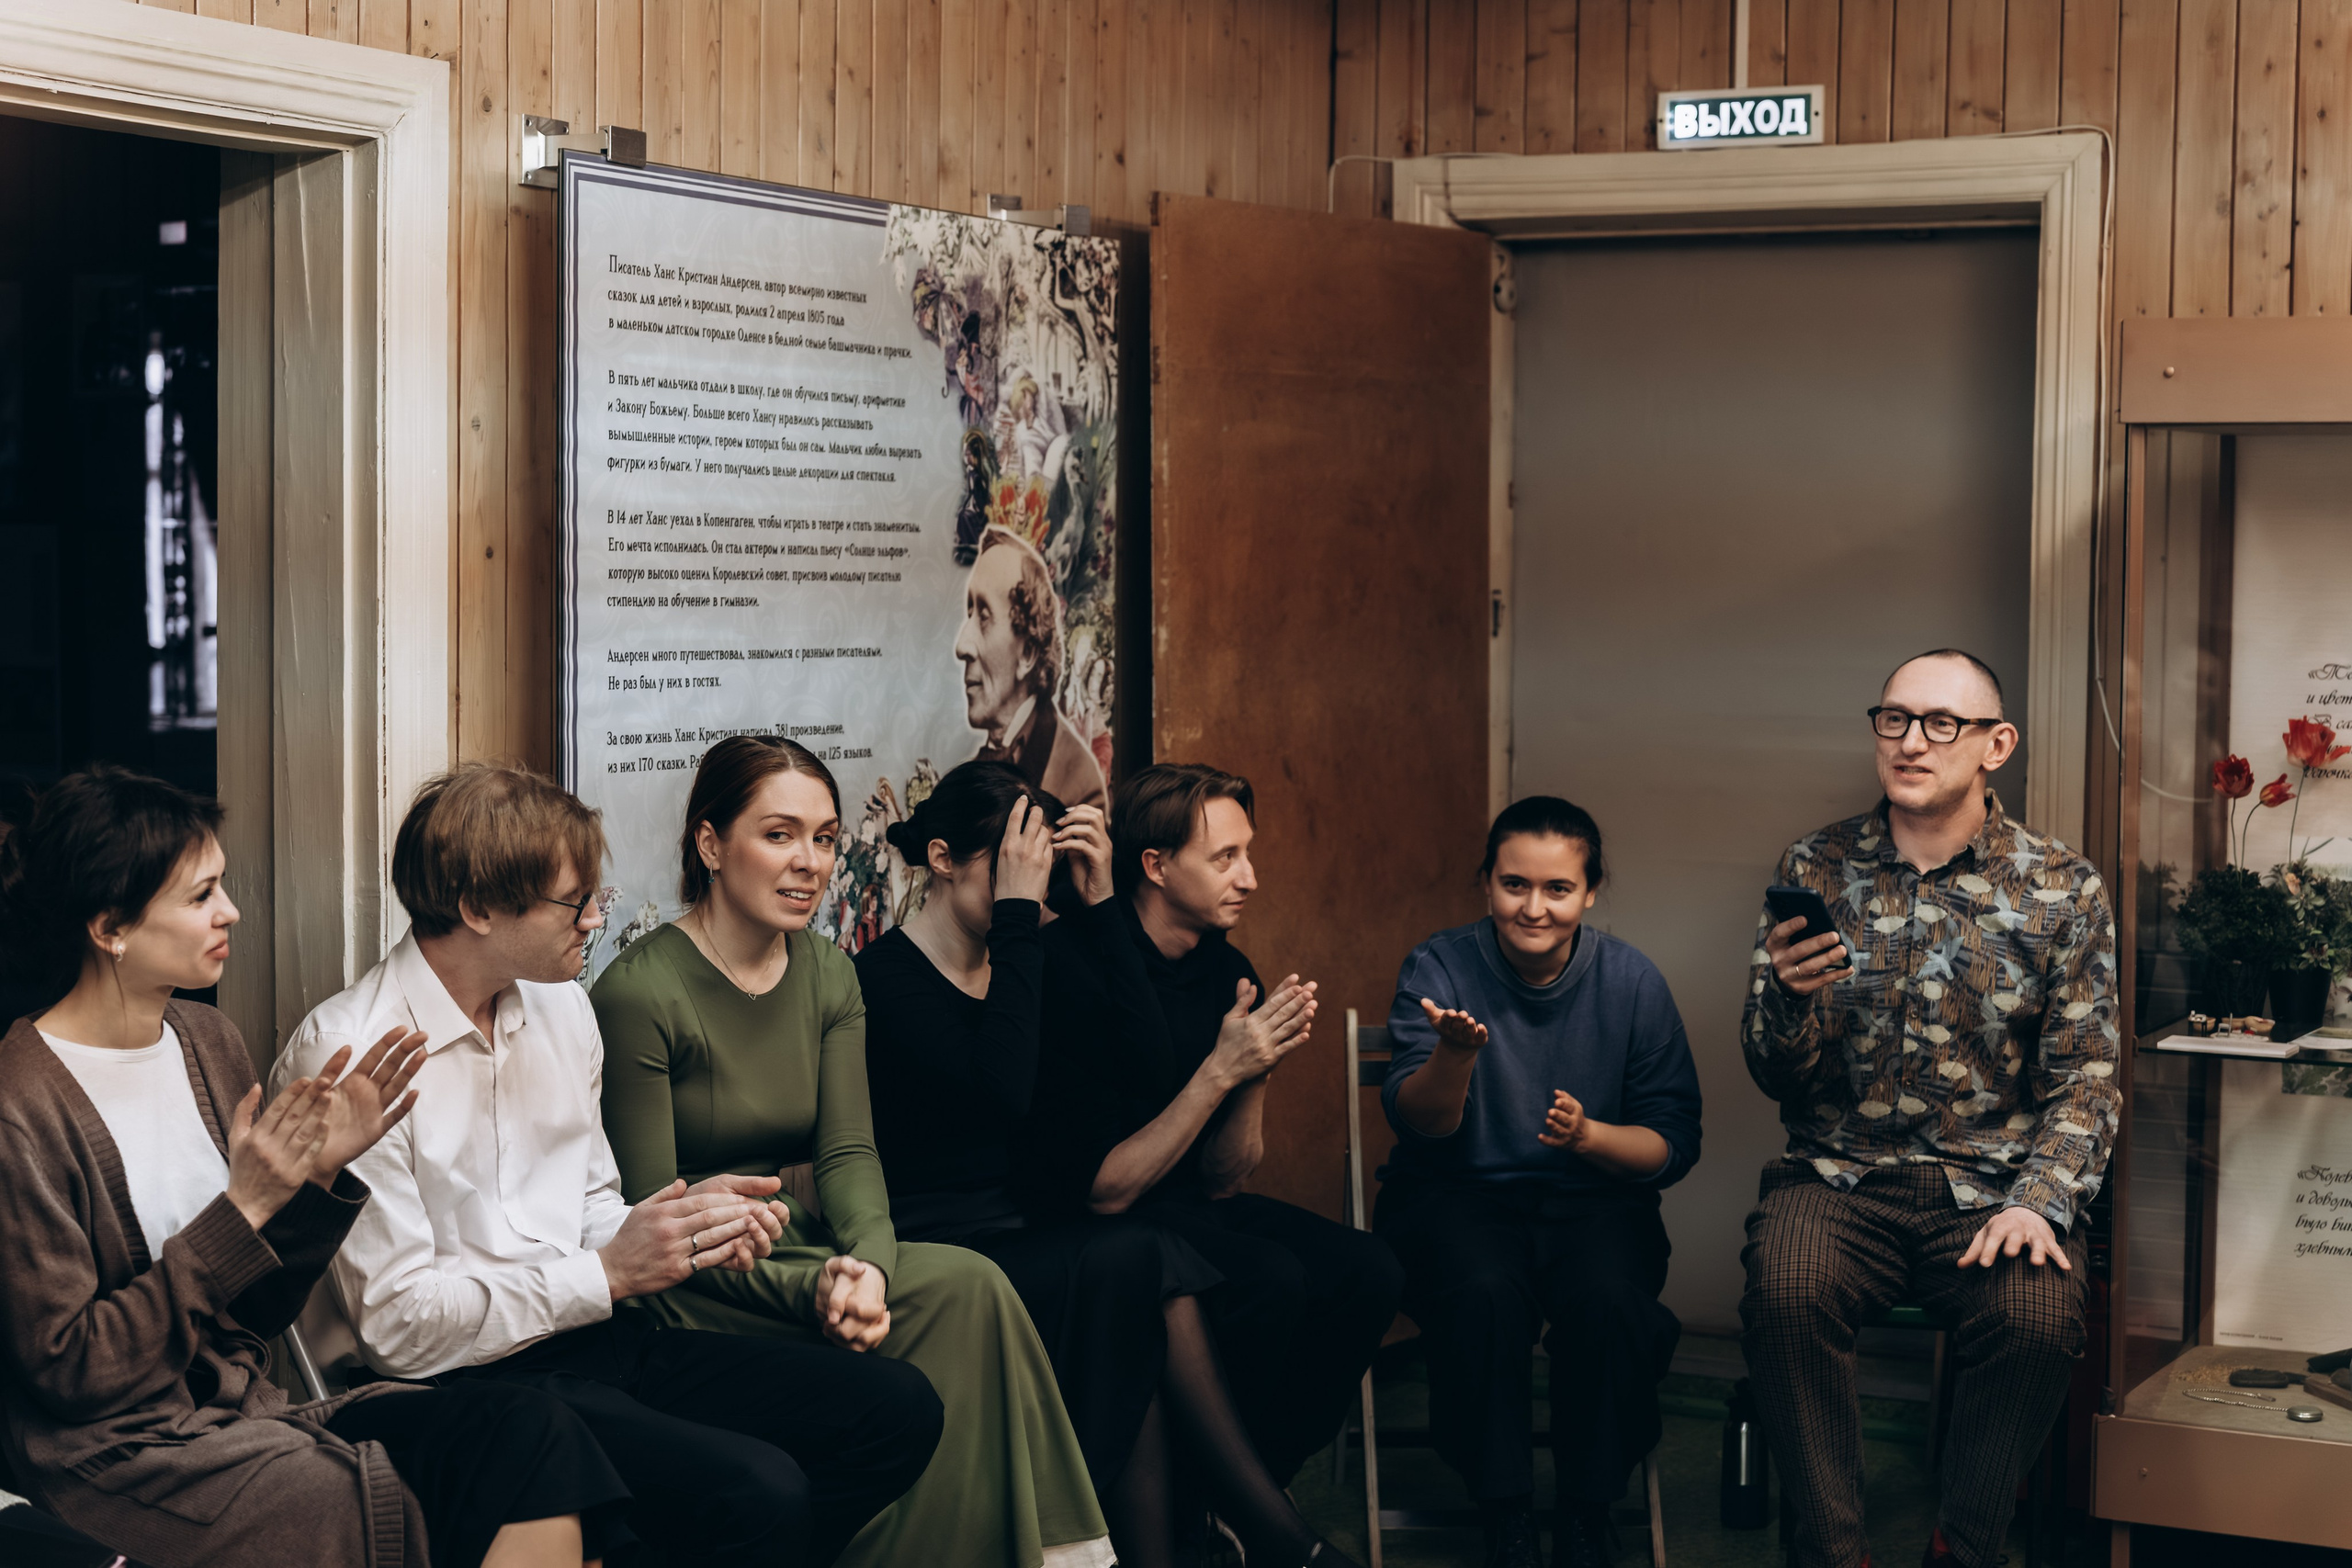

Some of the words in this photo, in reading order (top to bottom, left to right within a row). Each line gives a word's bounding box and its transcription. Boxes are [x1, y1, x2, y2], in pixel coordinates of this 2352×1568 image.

[1674, 97, 1808, 138] ВЫХОД
[609, 254, 650, 276] Писатель
[654, 264, 675, 279] Ханс
[678, 266, 717, 285] Кристиан
[764, 281, 786, 297] автор
[788, 284, 825, 299] всемирно
[827, 288, 866, 303] известных
[607, 289, 637, 302] сказок
[639, 294, 655, 304] для
[657, 296, 682, 307] детей
[684, 299, 689, 308] и
[735, 304, 767, 318] родился
[769, 305, 775, 318] 2
[776, 309, 805, 323] апреля
[807, 310, 825, 323] 1805
[827, 314, 844, 326] года
[608, 318, 614, 328] в
[616, 320, 663, 333] маленьком
[664, 324, 699, 336] датском
[702, 327, 735, 342] городке
[737, 327, 766, 343] Оденсе
[767, 334, 773, 344] в
[774, 331, 803, 346] бедной
[804, 338, 827, 349] семье
[608, 369, 616, 384] В
[617, 374, 639, 386] пять
[640, 377, 655, 387] лет
[657, 378, 698, 390] мальчика
[700, 381, 728, 392] отдали
[729, 383, 735, 393] в
[766, 387, 780, 397] где
[781, 388, 792, 398] он
[794, 386, 829, 402] обучился
[607, 401, 613, 412] и
[615, 398, 647, 417] Закону
[693, 403, 725, 419] Больше
[727, 410, 750, 421] всего
[752, 408, 776, 426] Хансу
[778, 414, 820, 427] нравилось
[821, 417, 873, 430] рассказывать
[608, 429, 675, 443] вымышленные
[715, 436, 742, 450] героем
[745, 438, 779, 452] которых
[781, 436, 797, 450] был
[798, 441, 808, 451] он
[828, 442, 862, 454] Мальчик
[864, 443, 887, 456] любил
[888, 446, 922, 460] вырезать
[606, 457, 645, 472] фигурки
[648, 459, 658, 469] из
[695, 458, 700, 471] У
[703, 462, 722, 473] него
[724, 464, 770, 478] получались
[772, 466, 797, 477] целые
[840, 470, 854, 479] для
[606, 509, 614, 523] В
[616, 509, 626, 524] 14
[628, 513, 643, 524] лет
[645, 510, 668, 525] Ханс
[670, 514, 694, 529] уехал
[696, 516, 701, 525] в
[757, 515, 781, 528] чтобы
[783, 519, 809, 532] играть
[811, 520, 816, 529] в
[818, 520, 844, 534] театре
[852, 521, 872, 531] стать
[608, 536, 624, 551] Его
[627, 541, 651, 551] мечта
[711, 539, 722, 553] Он
[725, 543, 742, 553] стал
[744, 544, 777, 558] актером
[780, 545, 785, 554] и
[820, 546, 842, 558] пьесу
[607, 569, 645, 582] которую
[647, 569, 679, 579] высоко
[680, 570, 710, 580] оценил
[712, 566, 763, 584] Королевский
[829, 571, 865, 585] молодому
[606, 596, 655, 606] стипендию
[658, 596, 668, 606] на
[671, 593, 710, 608] обучение
[712, 596, 718, 606] в
[607, 649, 649, 665] Андерсен
[651, 650, 677, 660] много
[747, 649, 792, 659] знакомился
[795, 649, 799, 658] с
[801, 648, 834, 661] разными
[608, 675, 619, 689] Не
[623, 679, 638, 693] раз
[639, 674, 656, 688] был
[658, 678, 664, 692] у
[666, 678, 682, 688] них
[684, 678, 690, 687] в
[692, 677, 721, 687] гостях.
[606, 731, 617, 745] За
[619, 733, 642, 744] свою
[645, 732, 672, 743] жизнь
[674, 728, 695, 741] Ханс
[698, 728, 737, 744] Кристиан
[775, 724, 788, 738] 381
[607, 762, 617, 773] из
[619, 761, 636, 773] них
[639, 757, 653, 771] 170
[656, 759, 687, 770] сказки.
[818, 750, 827, 761] на
[829, 746, 842, 760] 125
[843, 748, 873, 759] языков.
[2296, 1193, 2305, 1203] и
[2295, 1213, 2328, 1235] было
